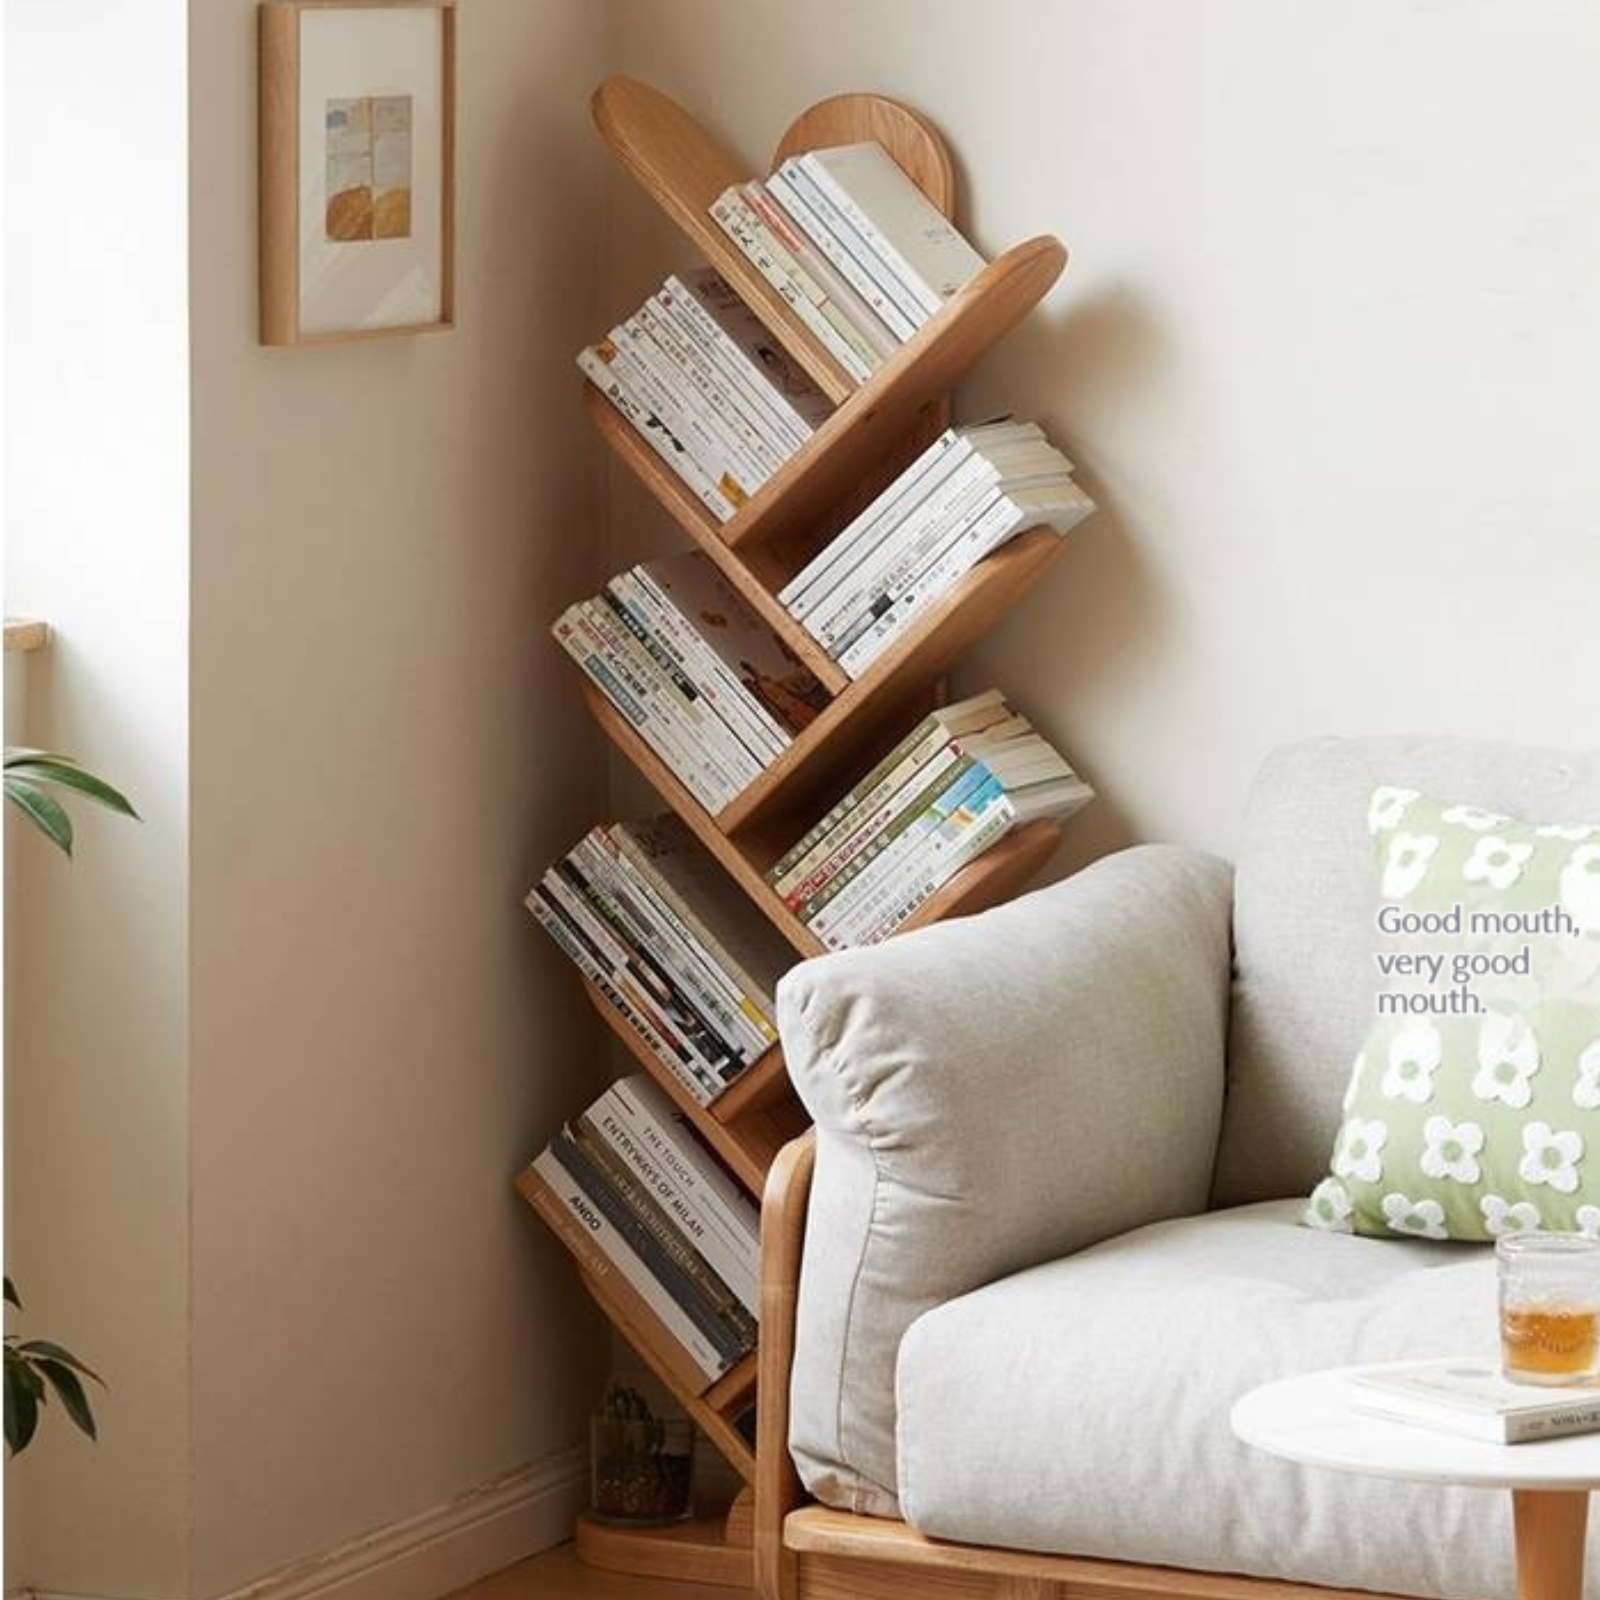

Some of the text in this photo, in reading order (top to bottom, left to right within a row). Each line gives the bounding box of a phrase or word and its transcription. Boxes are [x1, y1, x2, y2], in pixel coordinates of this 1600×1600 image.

[602, 1116, 705, 1238] ENTRYWAYS OF MILAN
[643, 1127, 695, 1188] THE TOUCH
[568, 1196, 601, 1231] ANDO
